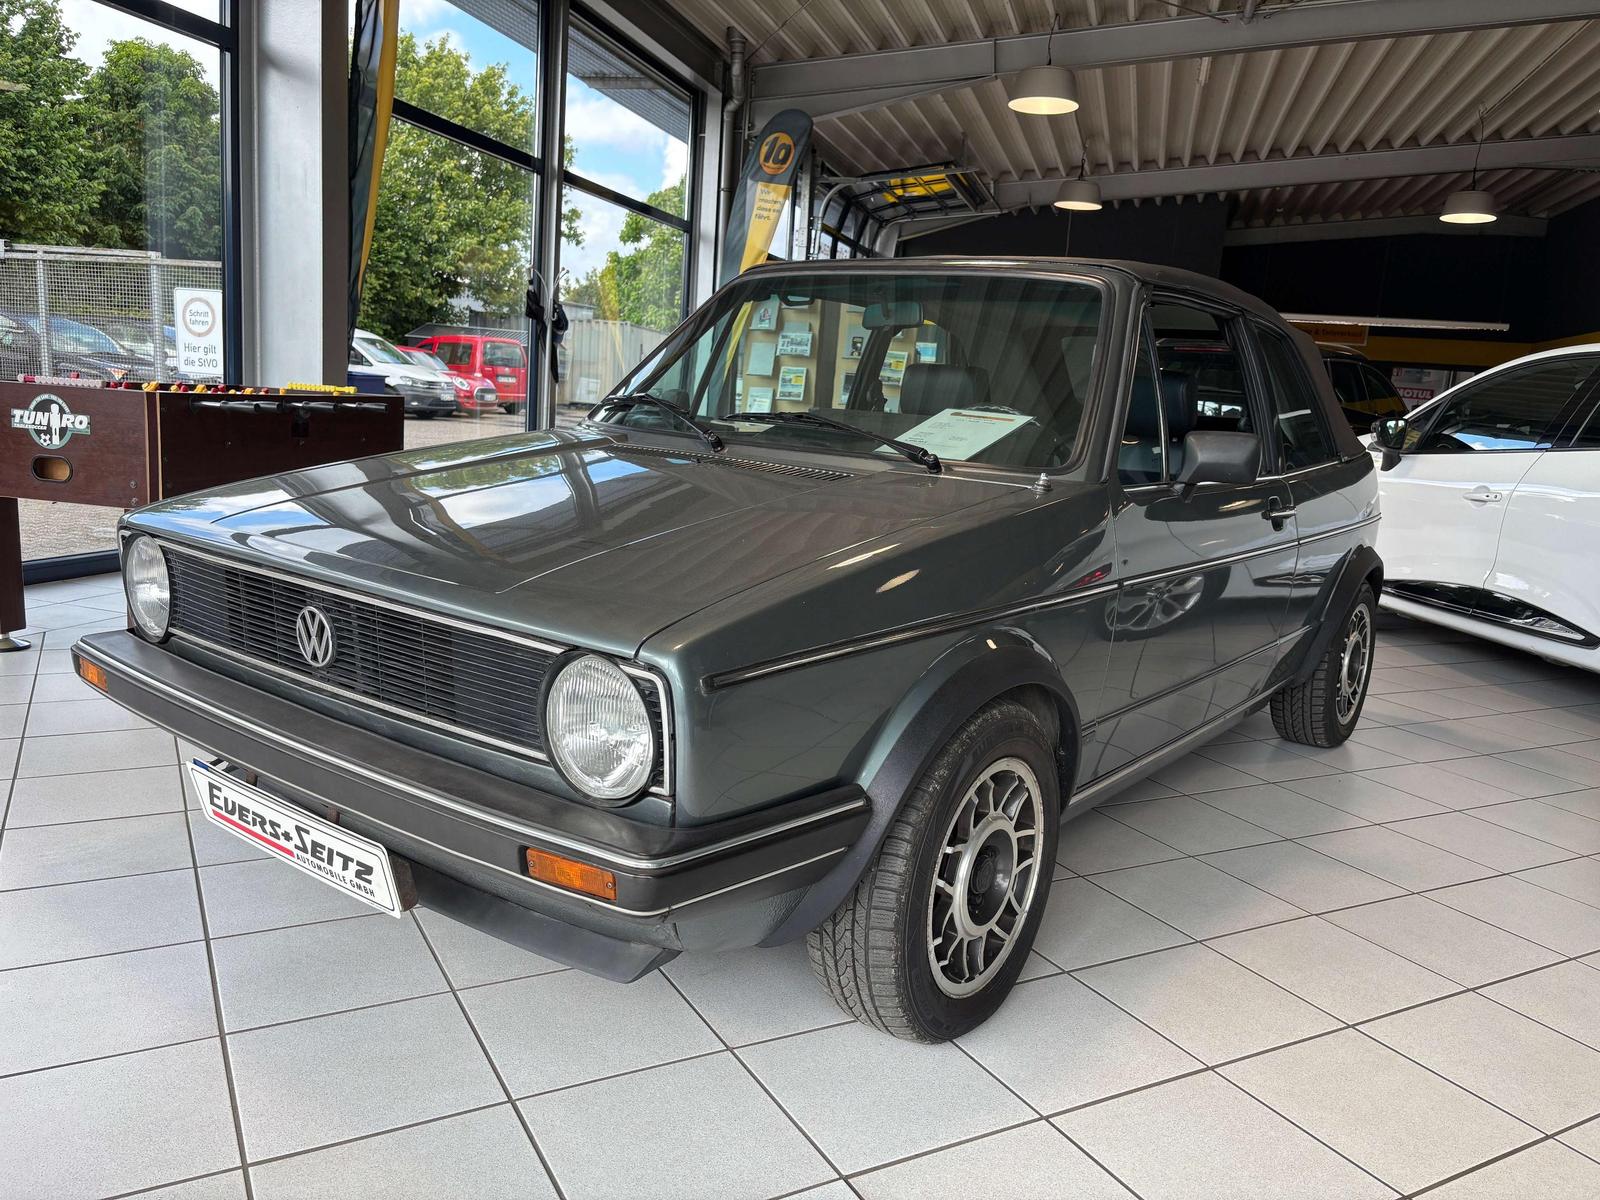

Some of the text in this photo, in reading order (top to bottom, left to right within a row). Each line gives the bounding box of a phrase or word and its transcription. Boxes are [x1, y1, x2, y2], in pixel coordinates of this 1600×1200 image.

[764, 136, 791, 165] 1a
[188, 309, 209, 318] Schritt
[189, 318, 209, 326] fahren
[184, 342, 216, 355] Hier gilt
[184, 357, 218, 368] die StVO
[296, 853, 348, 885] AUTOMOBILE
